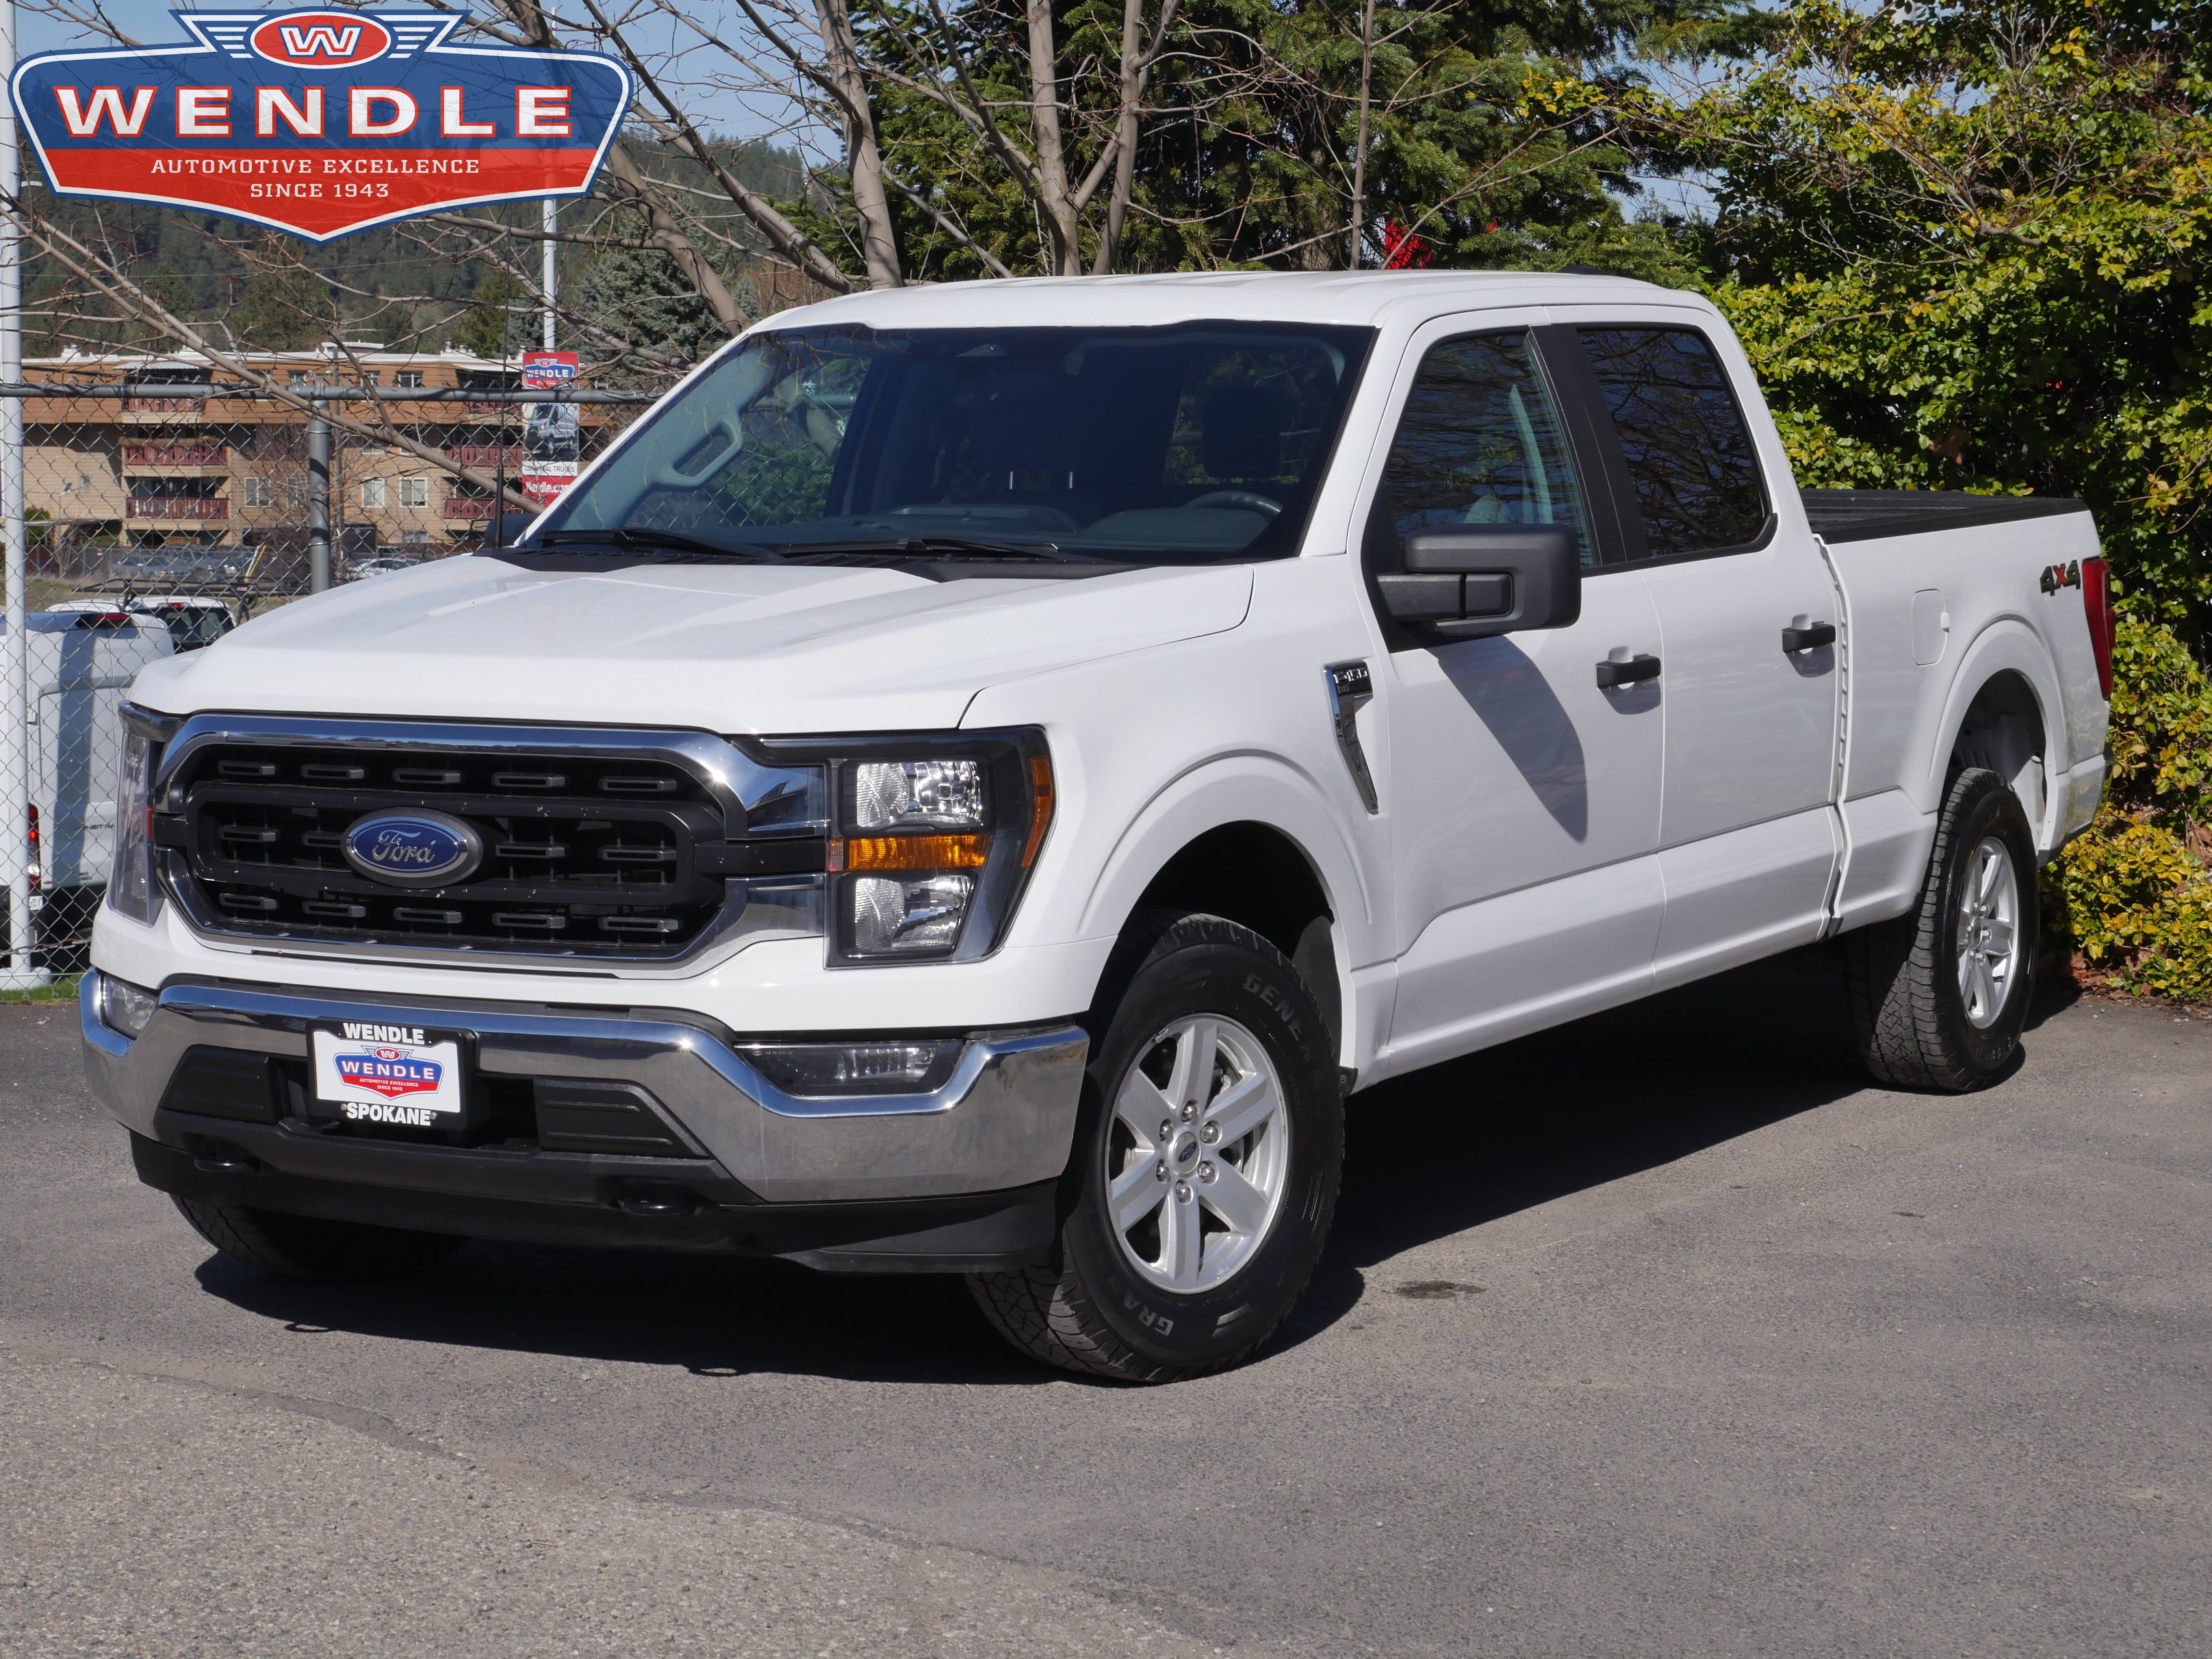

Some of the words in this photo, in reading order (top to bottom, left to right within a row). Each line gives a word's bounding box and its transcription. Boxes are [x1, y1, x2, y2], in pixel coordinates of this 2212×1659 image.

[526, 370, 569, 378] WENDLE
[372, 830, 437, 864] Ford
[343, 1023, 425, 1045] WENDLE
[341, 1061, 435, 1080] WENDLE
[346, 1103, 431, 1126] SPOKANE
